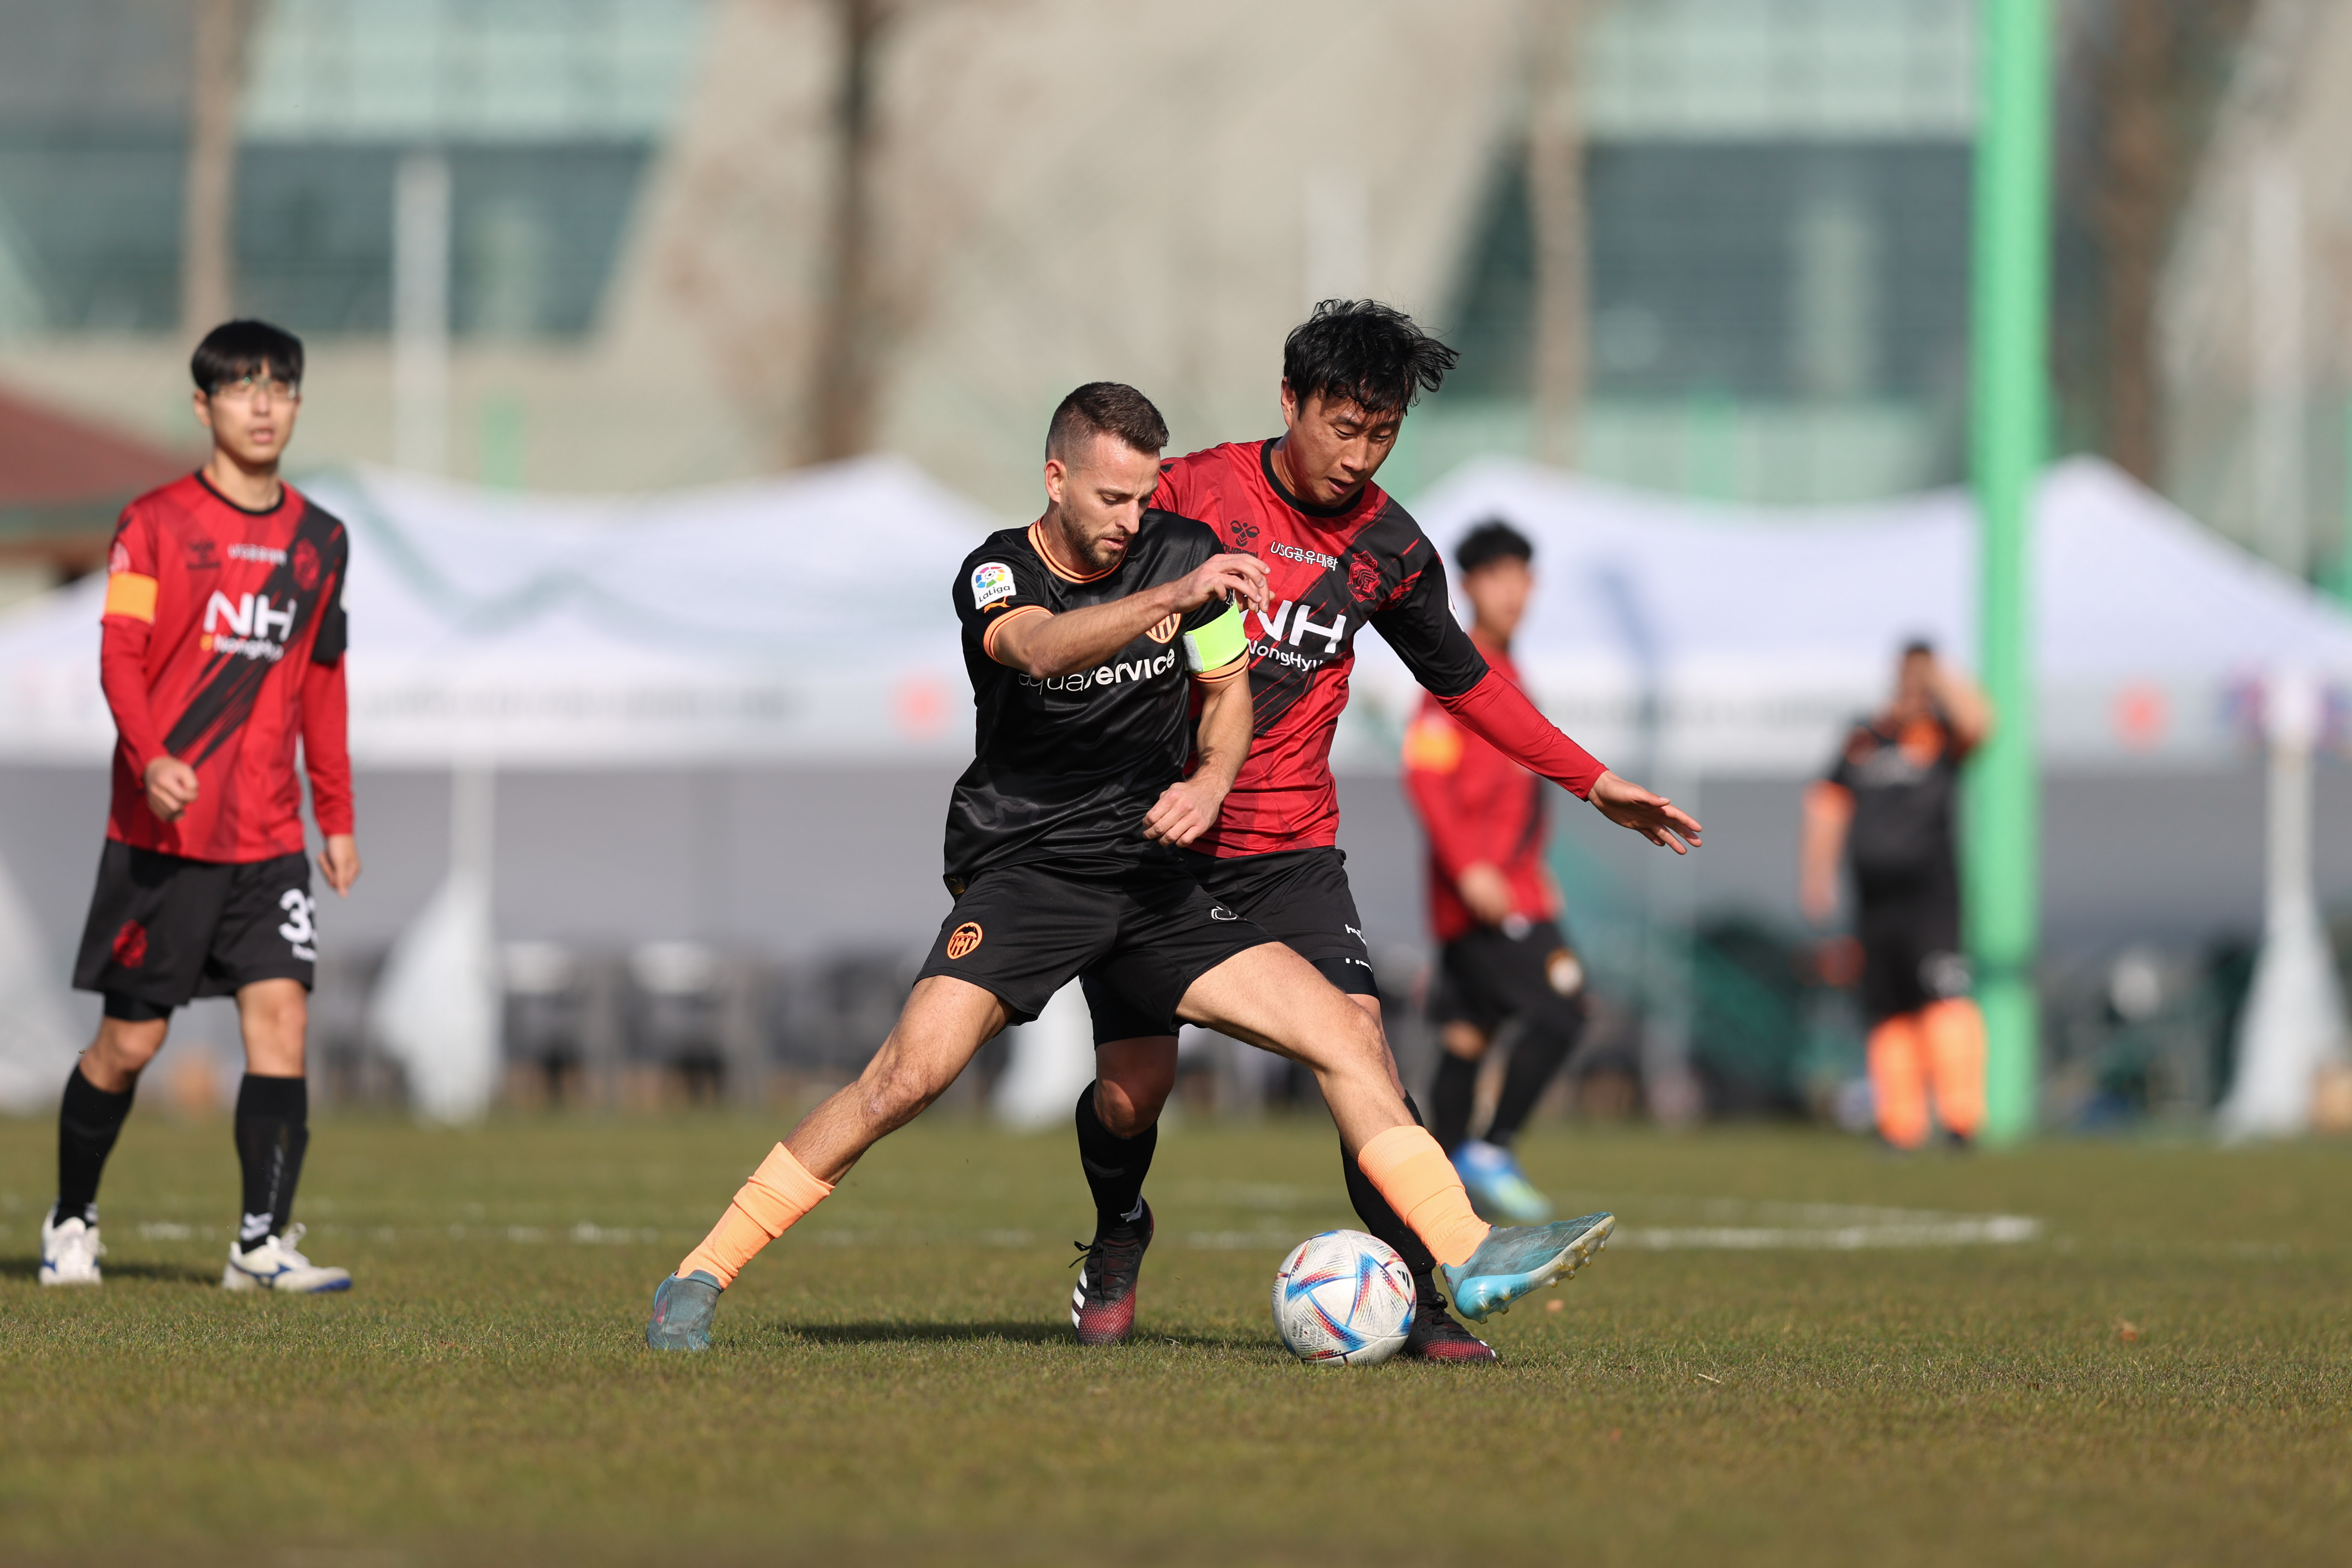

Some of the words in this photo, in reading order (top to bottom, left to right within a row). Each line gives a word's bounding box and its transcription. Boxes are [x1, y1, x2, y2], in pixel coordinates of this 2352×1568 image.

[203, 590, 298, 642] NH
[979, 586, 1010, 602] LaLiga
[1240, 599, 1347, 654] NH
[1246, 638, 1325, 672] NongHyu
[279, 888, 318, 944] 3
